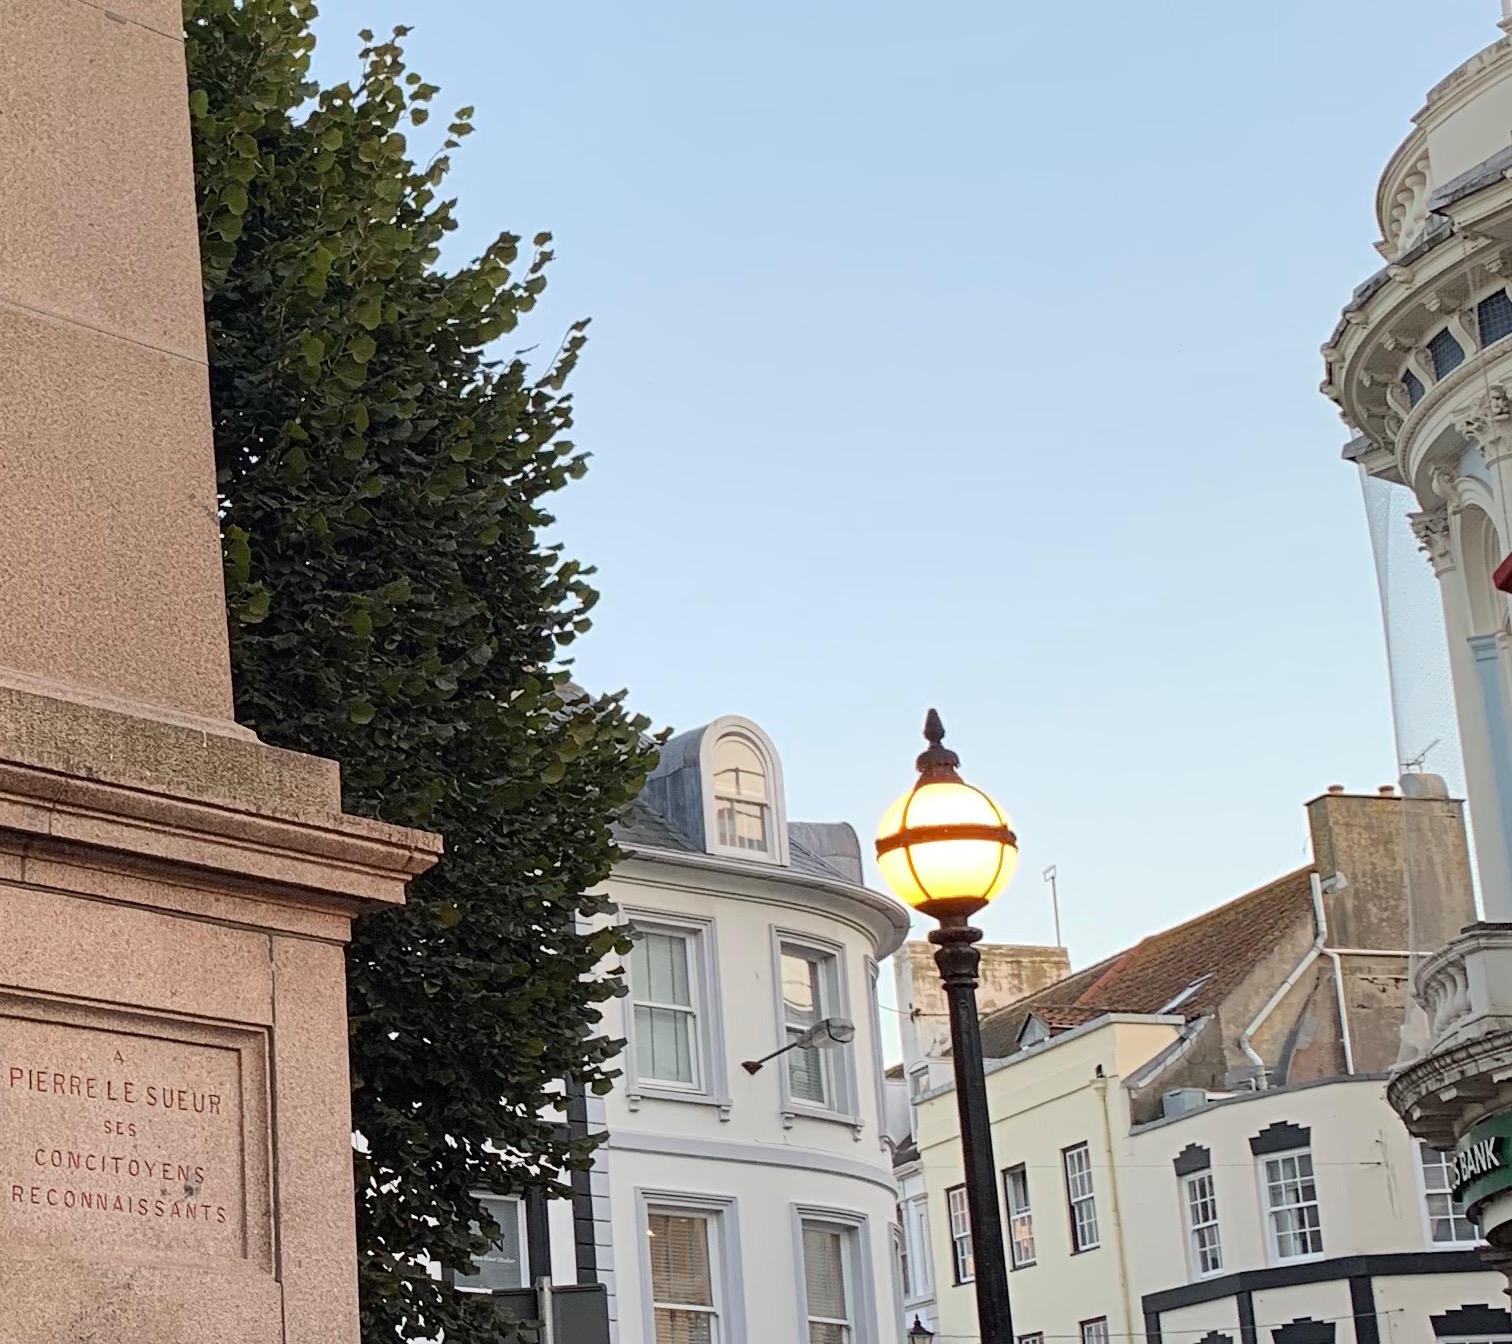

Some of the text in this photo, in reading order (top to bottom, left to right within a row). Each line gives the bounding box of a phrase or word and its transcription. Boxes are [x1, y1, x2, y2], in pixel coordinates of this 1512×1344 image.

[112, 1049, 124, 1065] A
[9, 1067, 221, 1115] PIERRE LE SUEUR
[103, 1119, 136, 1137] SES
[34, 1148, 205, 1184] CONCITOYENS
[1459, 1136, 1500, 1182] BANK
[12, 1185, 226, 1223] RECONNAISSANTS
